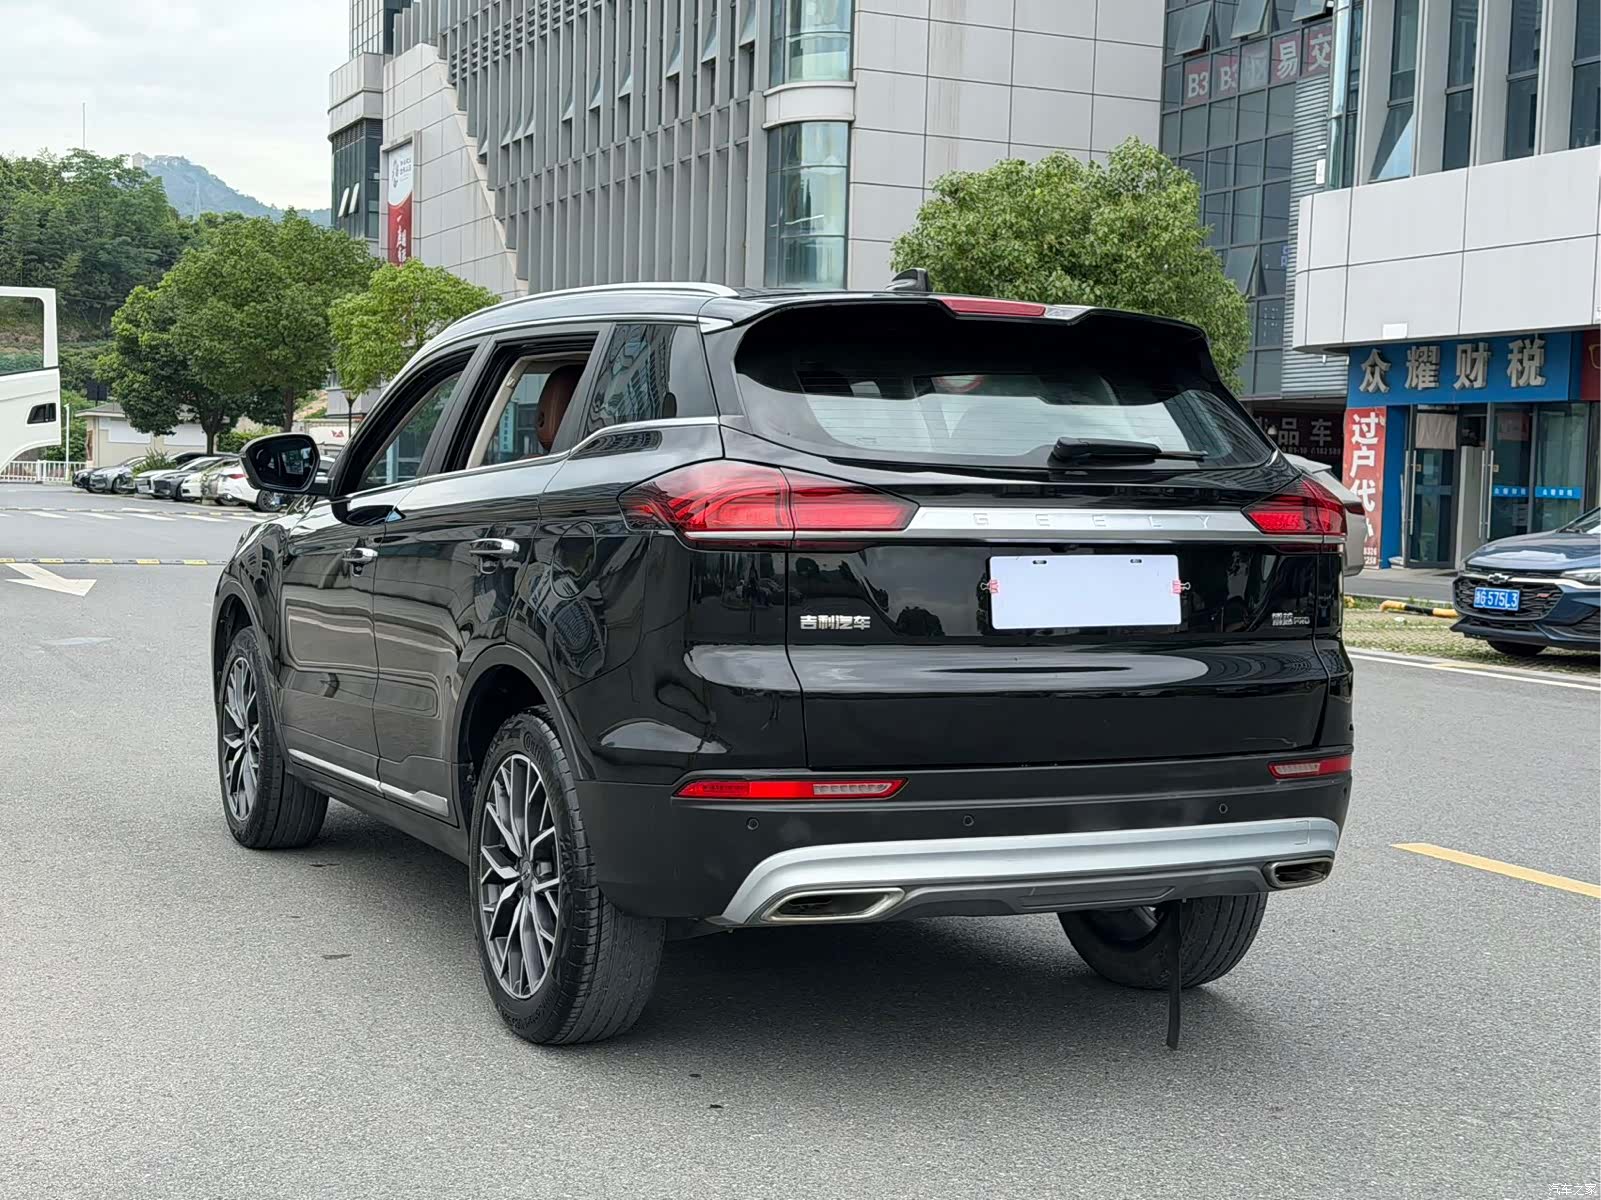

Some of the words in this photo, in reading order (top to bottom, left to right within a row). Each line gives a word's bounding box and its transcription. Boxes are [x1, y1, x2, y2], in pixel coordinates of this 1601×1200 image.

[1188, 71, 1208, 98] B3
[1359, 338, 1547, 393] 众耀财税
[973, 512, 1209, 528] GEELY
[800, 615, 871, 630] 吉利汽车
